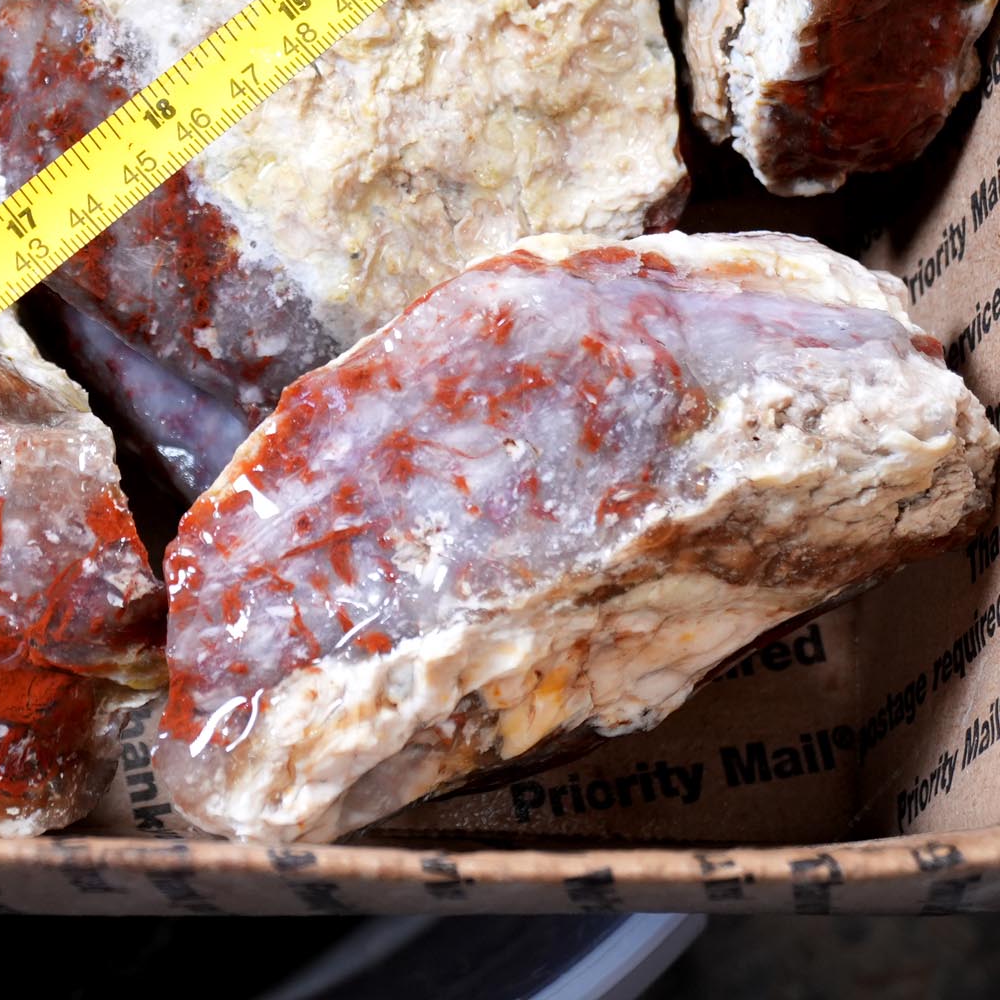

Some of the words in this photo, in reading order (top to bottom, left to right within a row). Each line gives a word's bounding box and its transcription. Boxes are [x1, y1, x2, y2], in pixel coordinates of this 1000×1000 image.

[7, 207, 36, 238] 17
[143, 98, 176, 129] 18
[15, 238, 49, 272] 43
[69, 193, 104, 228] 44
[123, 150, 157, 185] 45
[176, 107, 211, 142] 46
[230, 63, 260, 99] 47
[283, 22, 317, 56] 48
[903, 215, 966, 306] riority
[121, 705, 172, 829] hank
[511, 761, 704, 822] Priority
[897, 749, 958, 833] Priority
